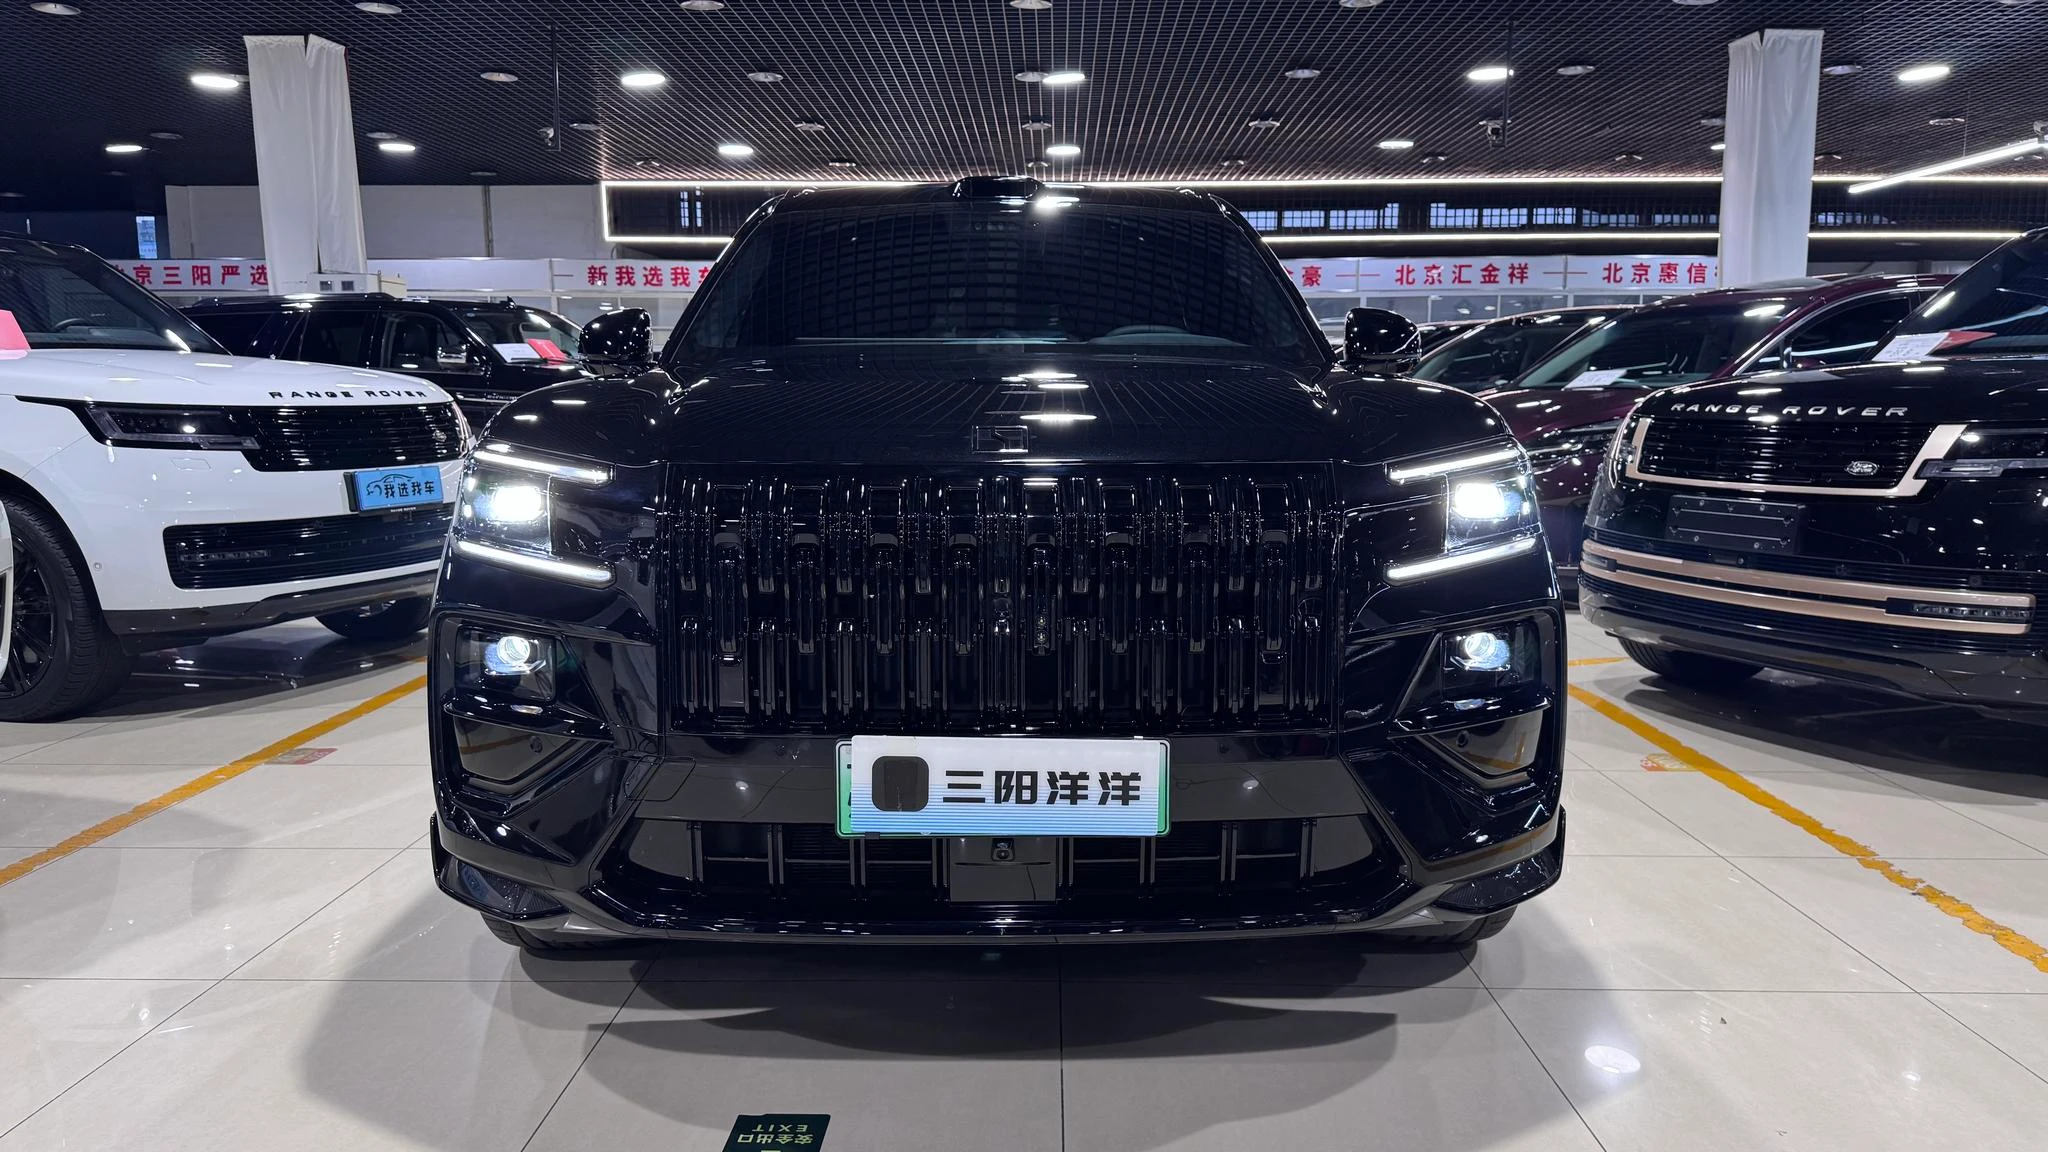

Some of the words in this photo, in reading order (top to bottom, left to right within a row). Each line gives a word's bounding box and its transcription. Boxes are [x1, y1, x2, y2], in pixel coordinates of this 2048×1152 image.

[115, 264, 269, 286] 京三阳严选
[1283, 264, 1322, 287] 豪
[1395, 263, 1529, 286] 北京汇金祥
[1602, 262, 1718, 284] 北京惠信
[269, 391, 353, 399] RANGE
[364, 390, 428, 398] ROVER
[1671, 403, 1763, 414] RANGE
[1782, 406, 1908, 416] ROVER
[384, 480, 435, 499] 我选我车
[943, 770, 1141, 806] 三阳洋洋
[752, 1124, 808, 1132] EXIT
[737, 1134, 814, 1144] 安全出口
